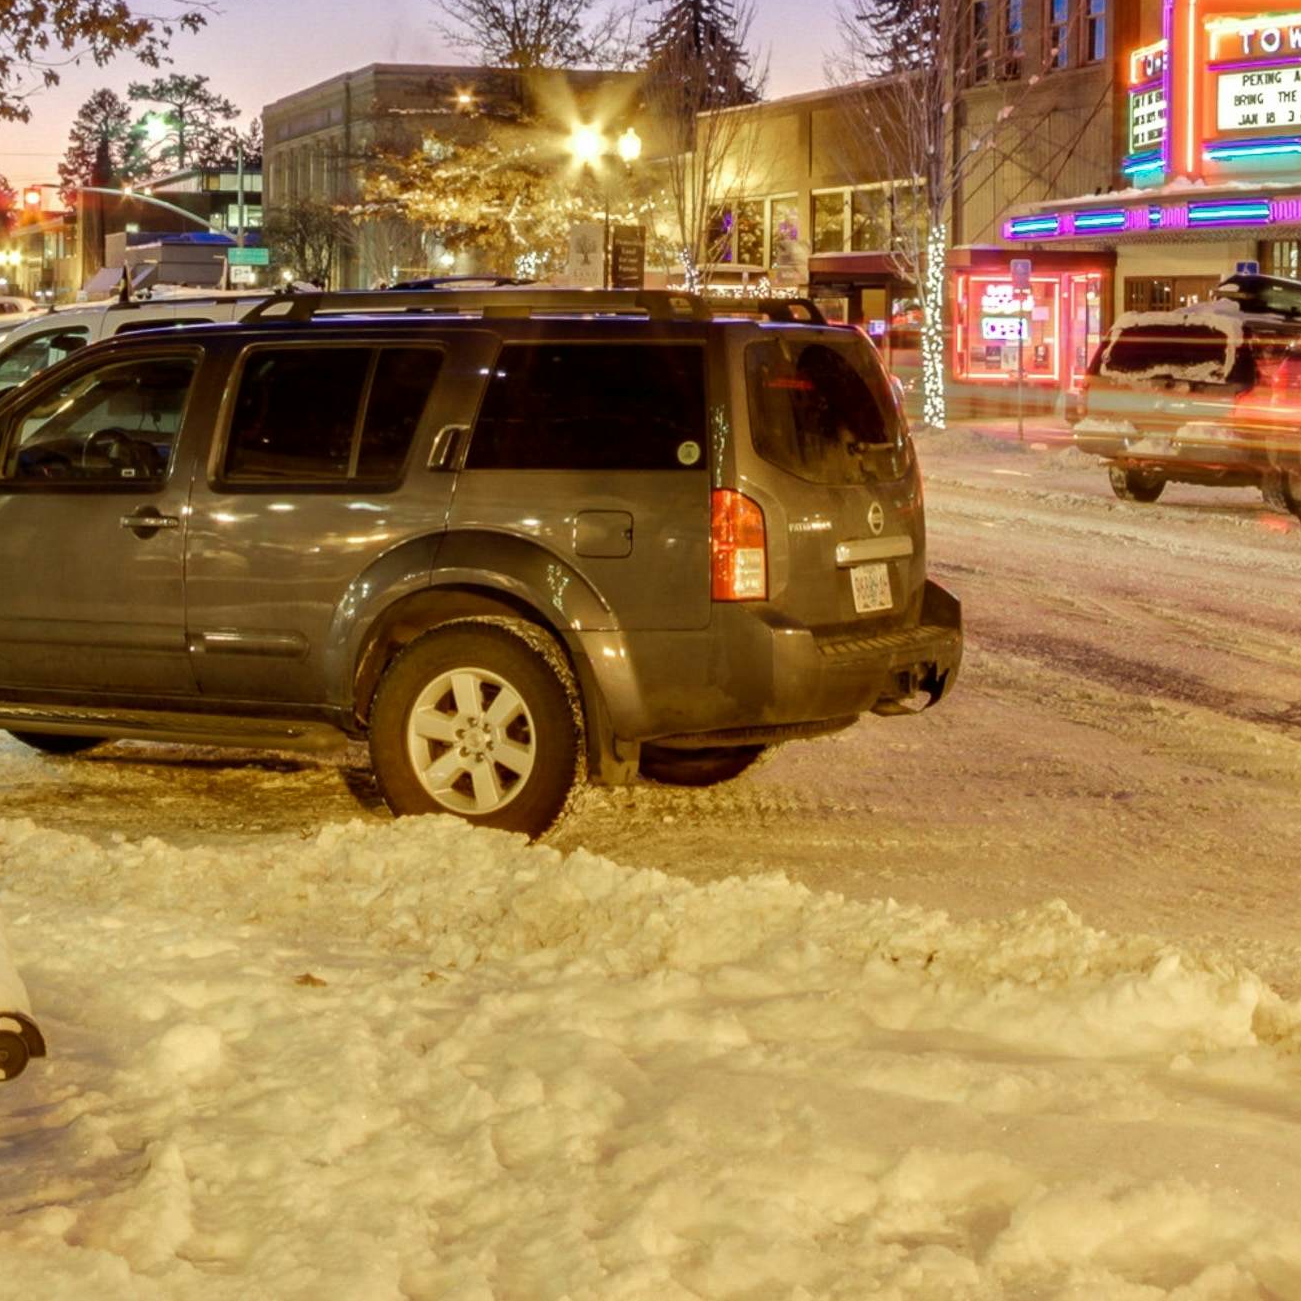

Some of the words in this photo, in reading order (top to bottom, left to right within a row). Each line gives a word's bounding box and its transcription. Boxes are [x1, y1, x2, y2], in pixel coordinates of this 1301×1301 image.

[1242, 72, 1282, 87] PEKING
[1234, 93, 1264, 106] BRING
[1278, 90, 1297, 102] THE
[1238, 113, 1258, 125] JAN
